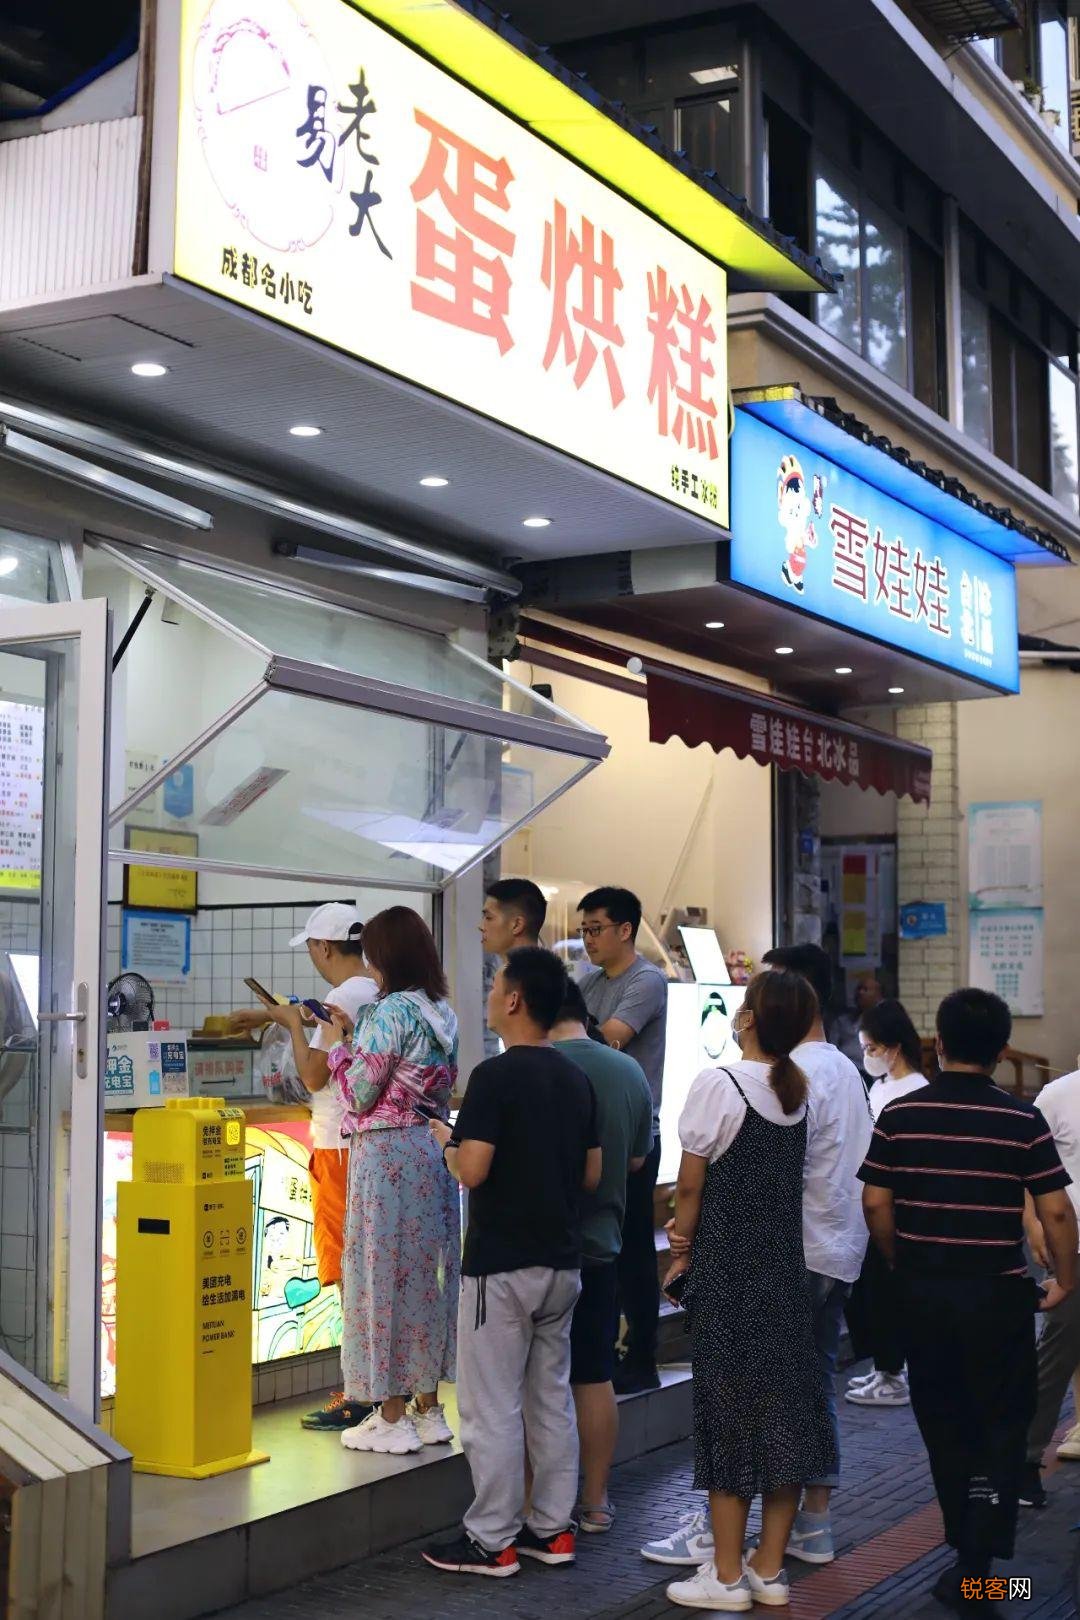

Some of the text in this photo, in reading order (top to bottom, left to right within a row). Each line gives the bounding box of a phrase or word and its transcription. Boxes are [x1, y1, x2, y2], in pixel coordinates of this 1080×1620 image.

[221, 246, 313, 315] 成都名小吃
[409, 106, 720, 462] 蛋烘糕
[830, 505, 950, 637] 雪娃娃
[750, 712, 860, 777] 雪娃娃台北冰品
[202, 1274, 232, 1290] 美团充电
